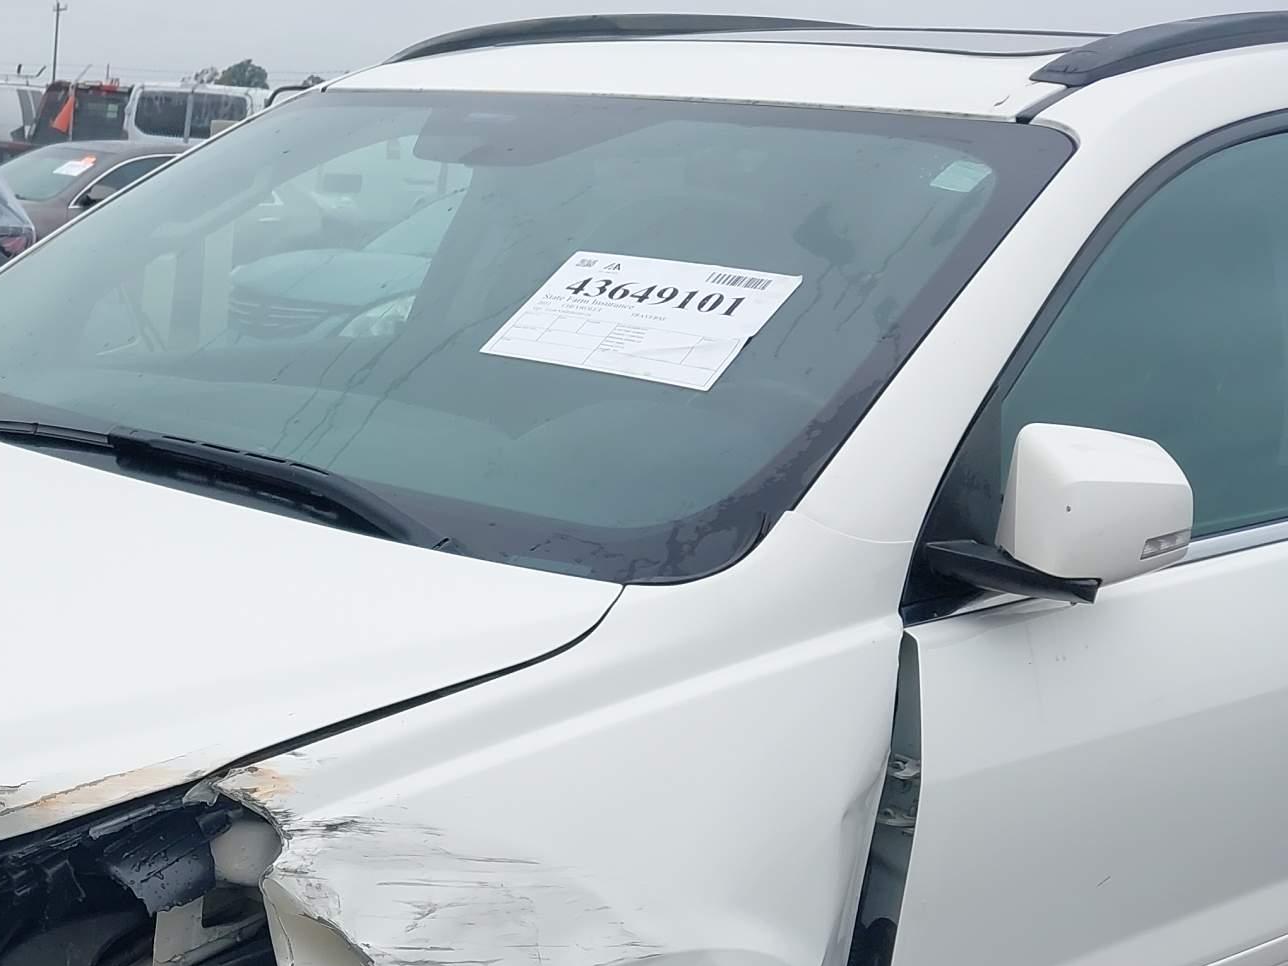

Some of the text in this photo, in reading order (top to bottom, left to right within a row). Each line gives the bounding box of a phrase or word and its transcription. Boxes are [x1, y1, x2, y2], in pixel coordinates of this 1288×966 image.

[543, 293, 635, 310] State Farm Insurance
[565, 276, 746, 317] 43649101
